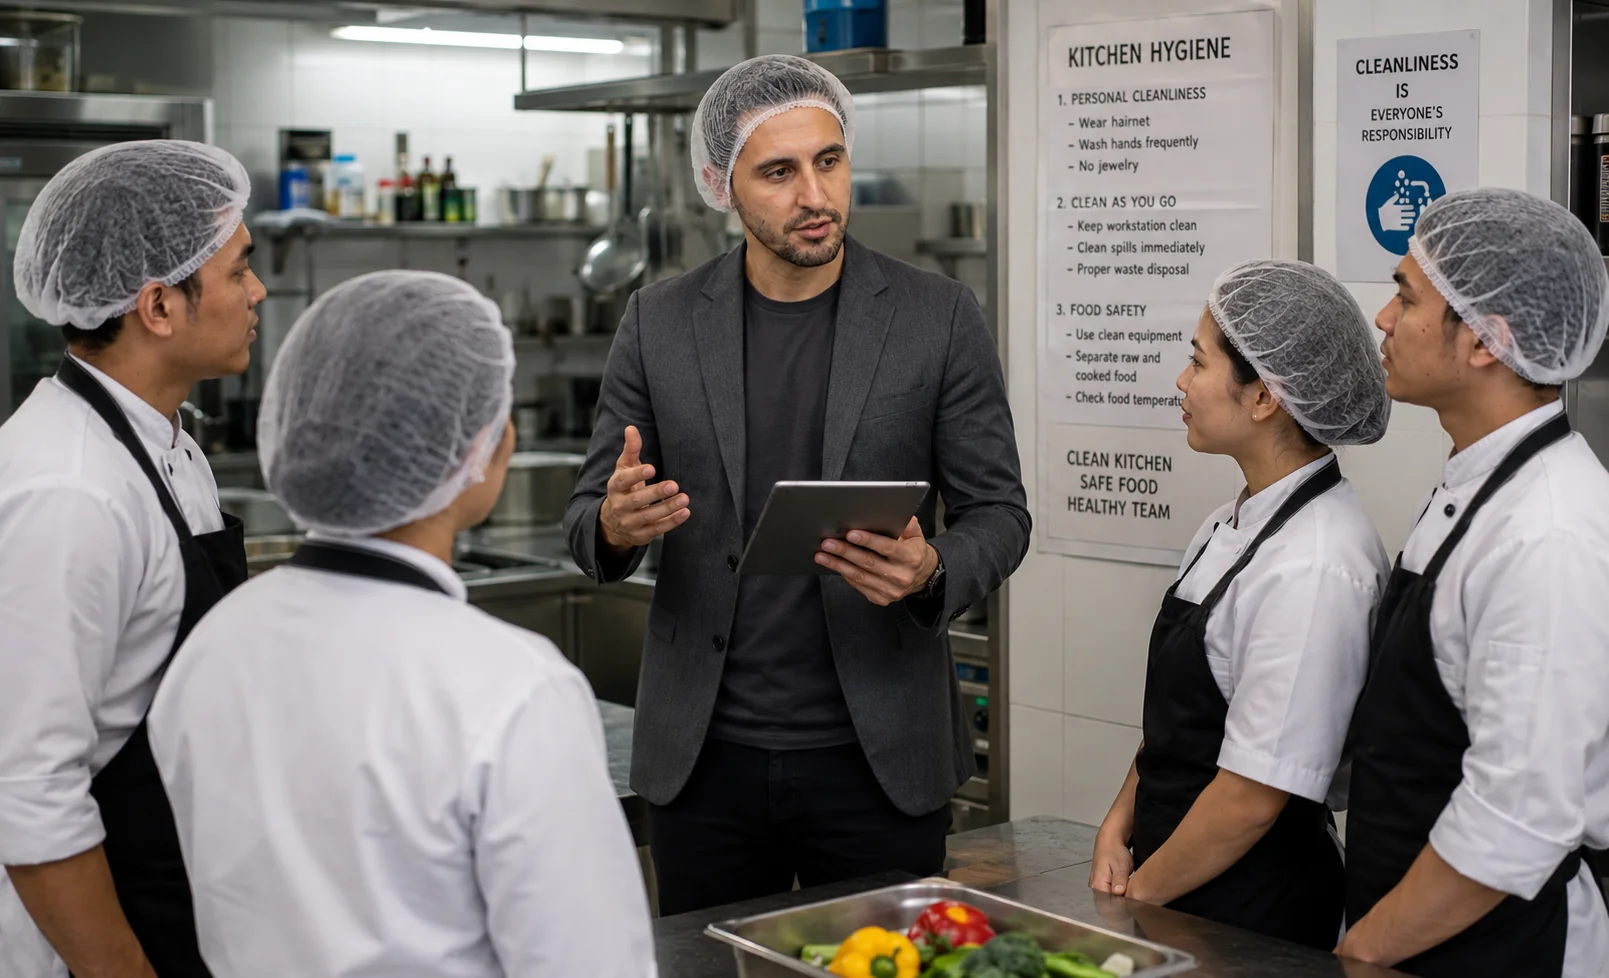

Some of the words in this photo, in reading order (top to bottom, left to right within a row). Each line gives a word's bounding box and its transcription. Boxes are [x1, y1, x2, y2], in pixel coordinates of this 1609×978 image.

[1069, 43, 1141, 67] KITCHEN
[1151, 37, 1230, 62] HYGIENE
[1356, 54, 1458, 74] CLEANLINESS
[1058, 94, 1066, 105] 1.
[1072, 91, 1128, 105] PERSONAL
[1133, 87, 1206, 102] CLEANLINESS
[1396, 83, 1409, 98] IS
[1372, 106, 1443, 121] EVERYONE’S
[1079, 118, 1107, 128] Wear
[1112, 116, 1149, 127] hairnet
[1362, 127, 1452, 141] RESPONSIBILITY
[1079, 138, 1107, 150] Wash
[1111, 137, 1142, 149] hands
[1146, 135, 1198, 150] frequently
[1080, 160, 1094, 171] No
[1098, 159, 1138, 174] jewelry
[1057, 197, 1066, 209] 2.
[1072, 197, 1106, 208] CLEAN
[1112, 196, 1126, 208] AS
[1131, 196, 1154, 208] YOU
[1160, 195, 1176, 207] GO
[1078, 221, 1103, 234] Keep
[1107, 220, 1166, 231] workstation
[1170, 219, 1196, 231] clean
[1078, 242, 1107, 253] Clean
[1111, 241, 1137, 256] spills
[1141, 241, 1205, 256] immediately
[1078, 263, 1111, 277] Proper
[1114, 265, 1143, 274] waste
[1147, 263, 1189, 278] disposal
[1056, 304, 1065, 315] 3.
[1071, 304, 1101, 316] FOOD
[1106, 304, 1146, 316] SAFETY
[1076, 329, 1094, 340] Use
[1098, 329, 1124, 340] clean
[1128, 330, 1182, 343] equipment
[1076, 350, 1118, 364] Separate
[1122, 354, 1139, 363] raw
[1142, 352, 1160, 363] and
[1076, 370, 1110, 381] cooked
[1114, 370, 1136, 382] food
[1076, 391, 1104, 403] Check
[1108, 392, 1130, 404] food
[1133, 394, 1183, 408] temperatu
[1067, 450, 1109, 467] CLEAN
[1115, 454, 1171, 472] KITCHEN
[1081, 474, 1113, 491] SAFE
[1119, 477, 1158, 494] FOOD
[1068, 496, 1126, 516] HEALTHY
[1132, 502, 1170, 519] TEAM
